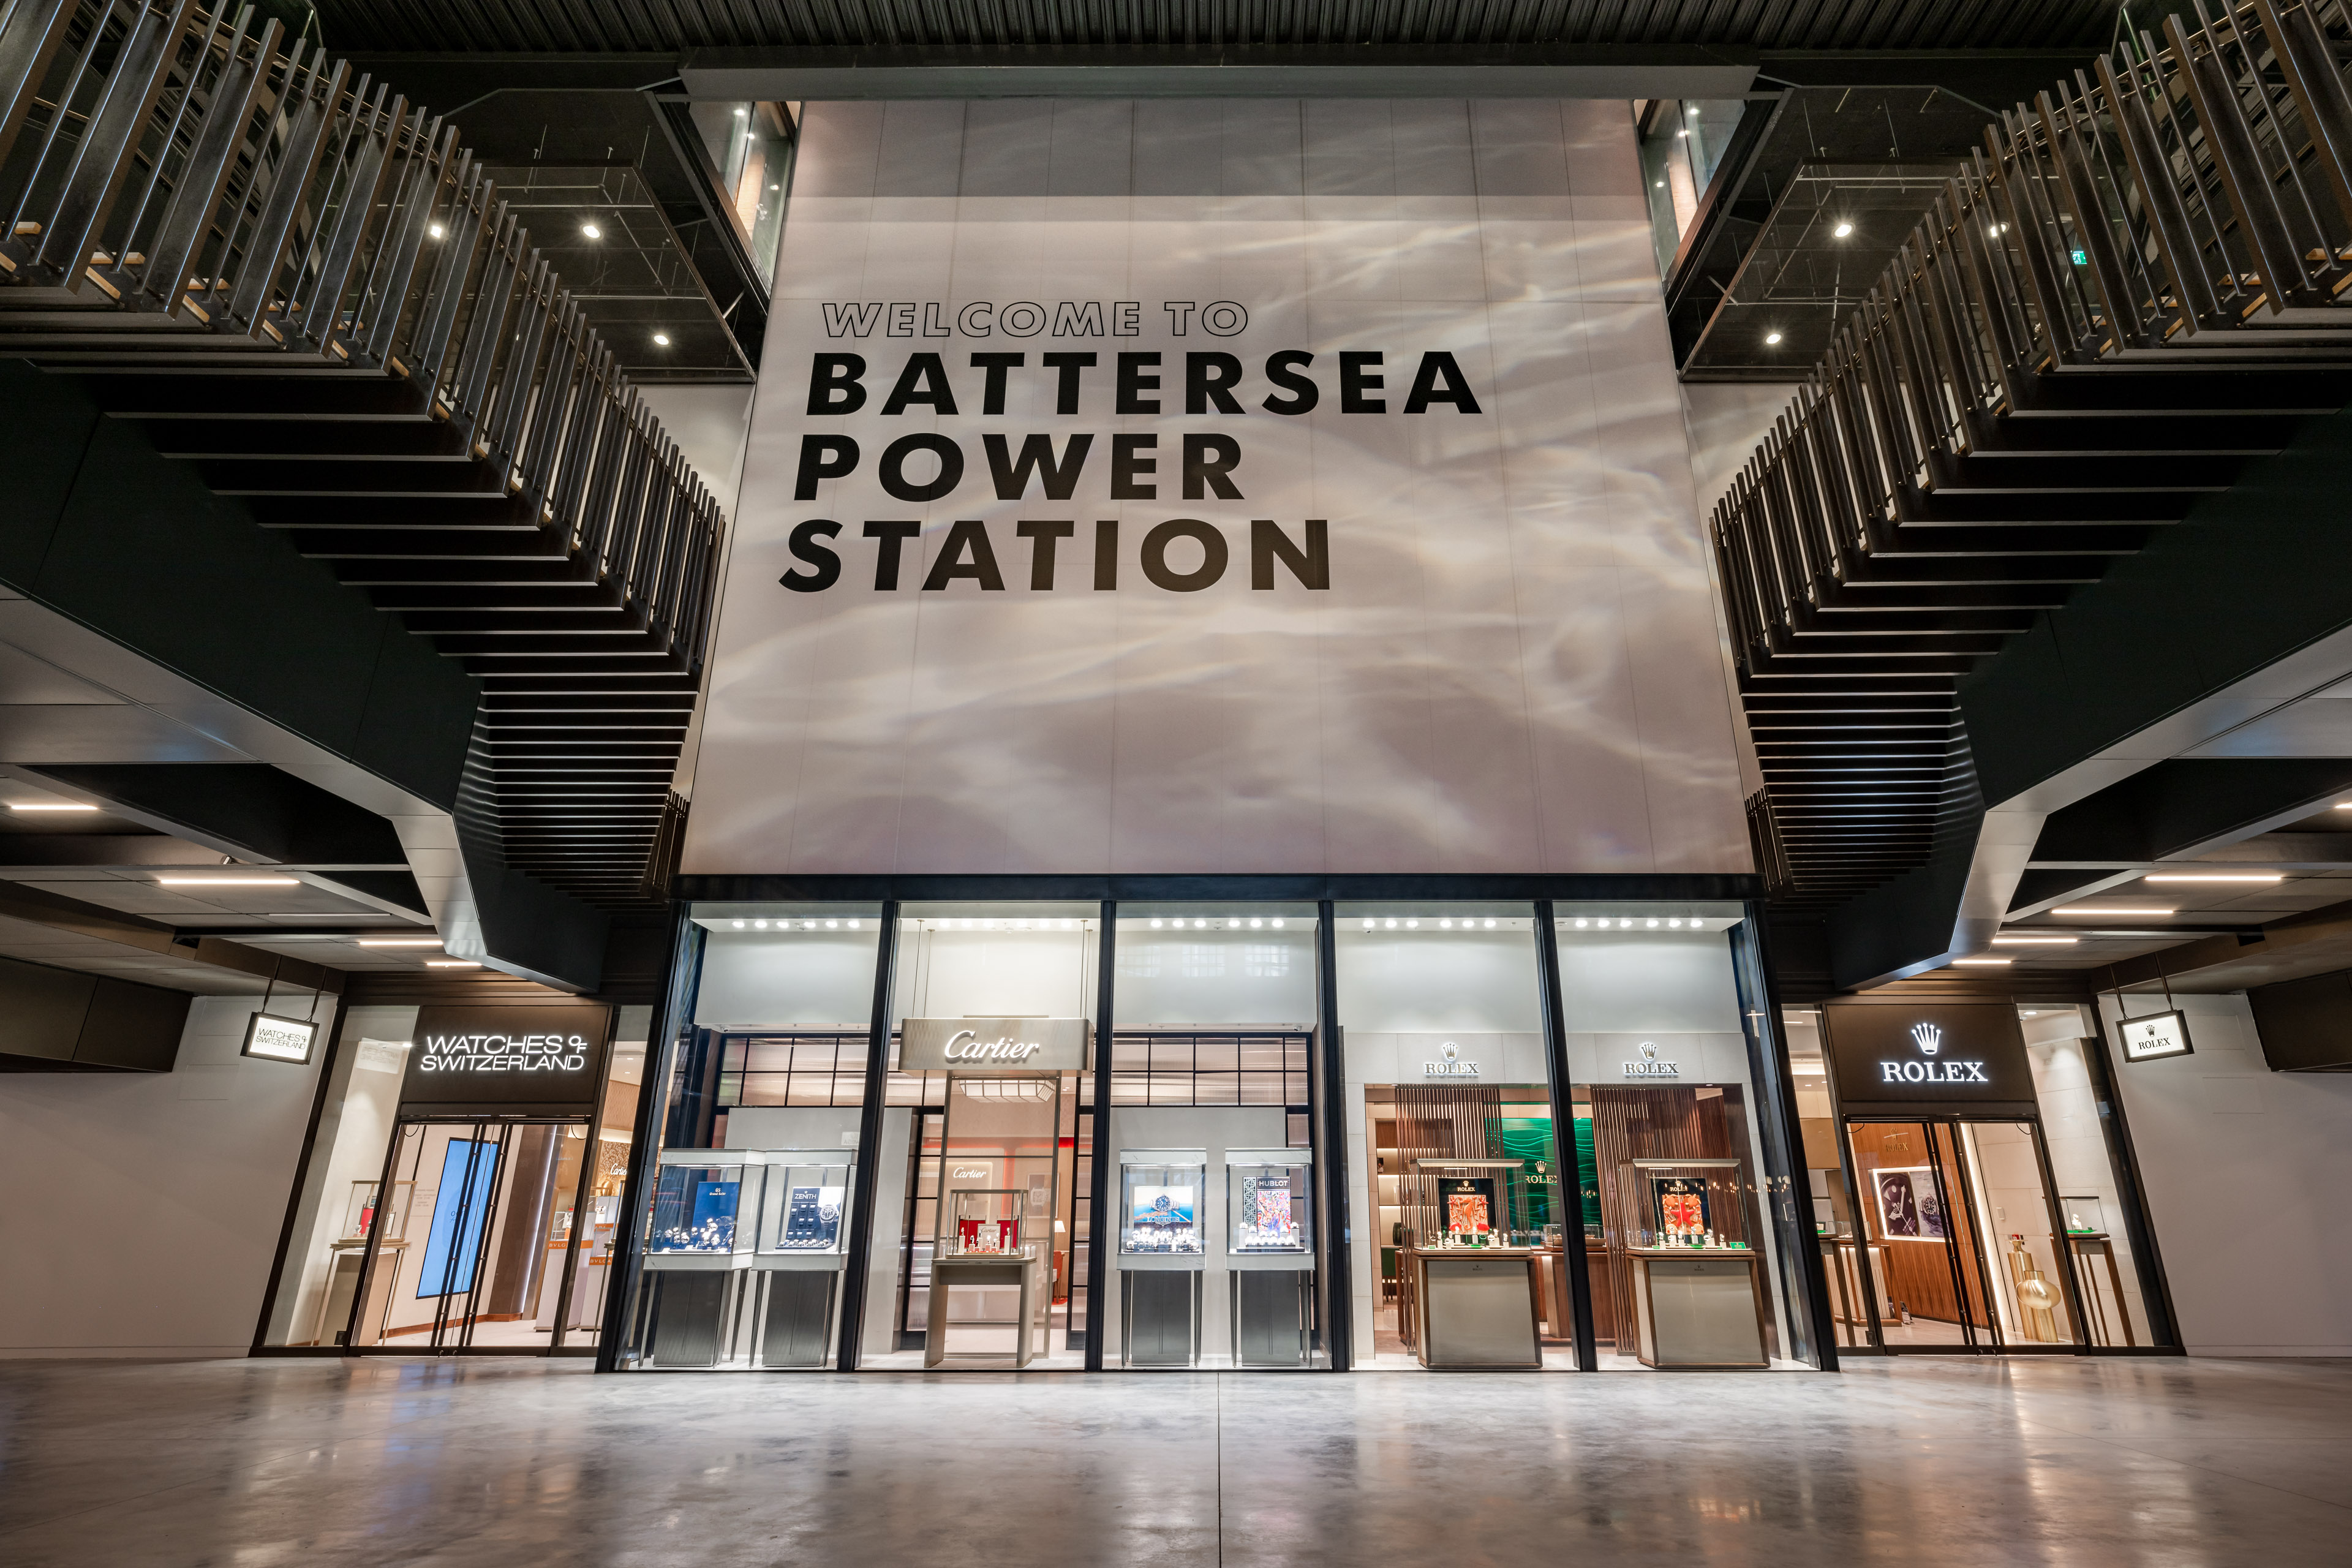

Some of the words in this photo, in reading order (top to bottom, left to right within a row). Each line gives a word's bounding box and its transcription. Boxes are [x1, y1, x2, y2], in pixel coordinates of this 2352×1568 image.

[821, 301, 1140, 338] WELCOME
[1164, 300, 1248, 337] TO
[805, 350, 1483, 416] BATTERSEA
[794, 432, 1245, 502] POWER
[778, 518, 1331, 593] STATION
[255, 1035, 306, 1050] SWITZERLAND
[258, 1028, 301, 1042] WATCHES
[427, 1035, 563, 1054] WATCHES
[944, 1030, 1040, 1058] Cartier
[2138, 1037, 2171, 1050] ROLEX
[420, 1055, 584, 1071] SWITZERLAND
[1425, 1063, 1479, 1074] ROLEX
[1624, 1063, 1679, 1074] ROLEX
[1880, 1061, 1988, 1082] ROLEX
[610, 1163, 627, 1175] Cartie
[953, 1167, 987, 1178] Cartier
